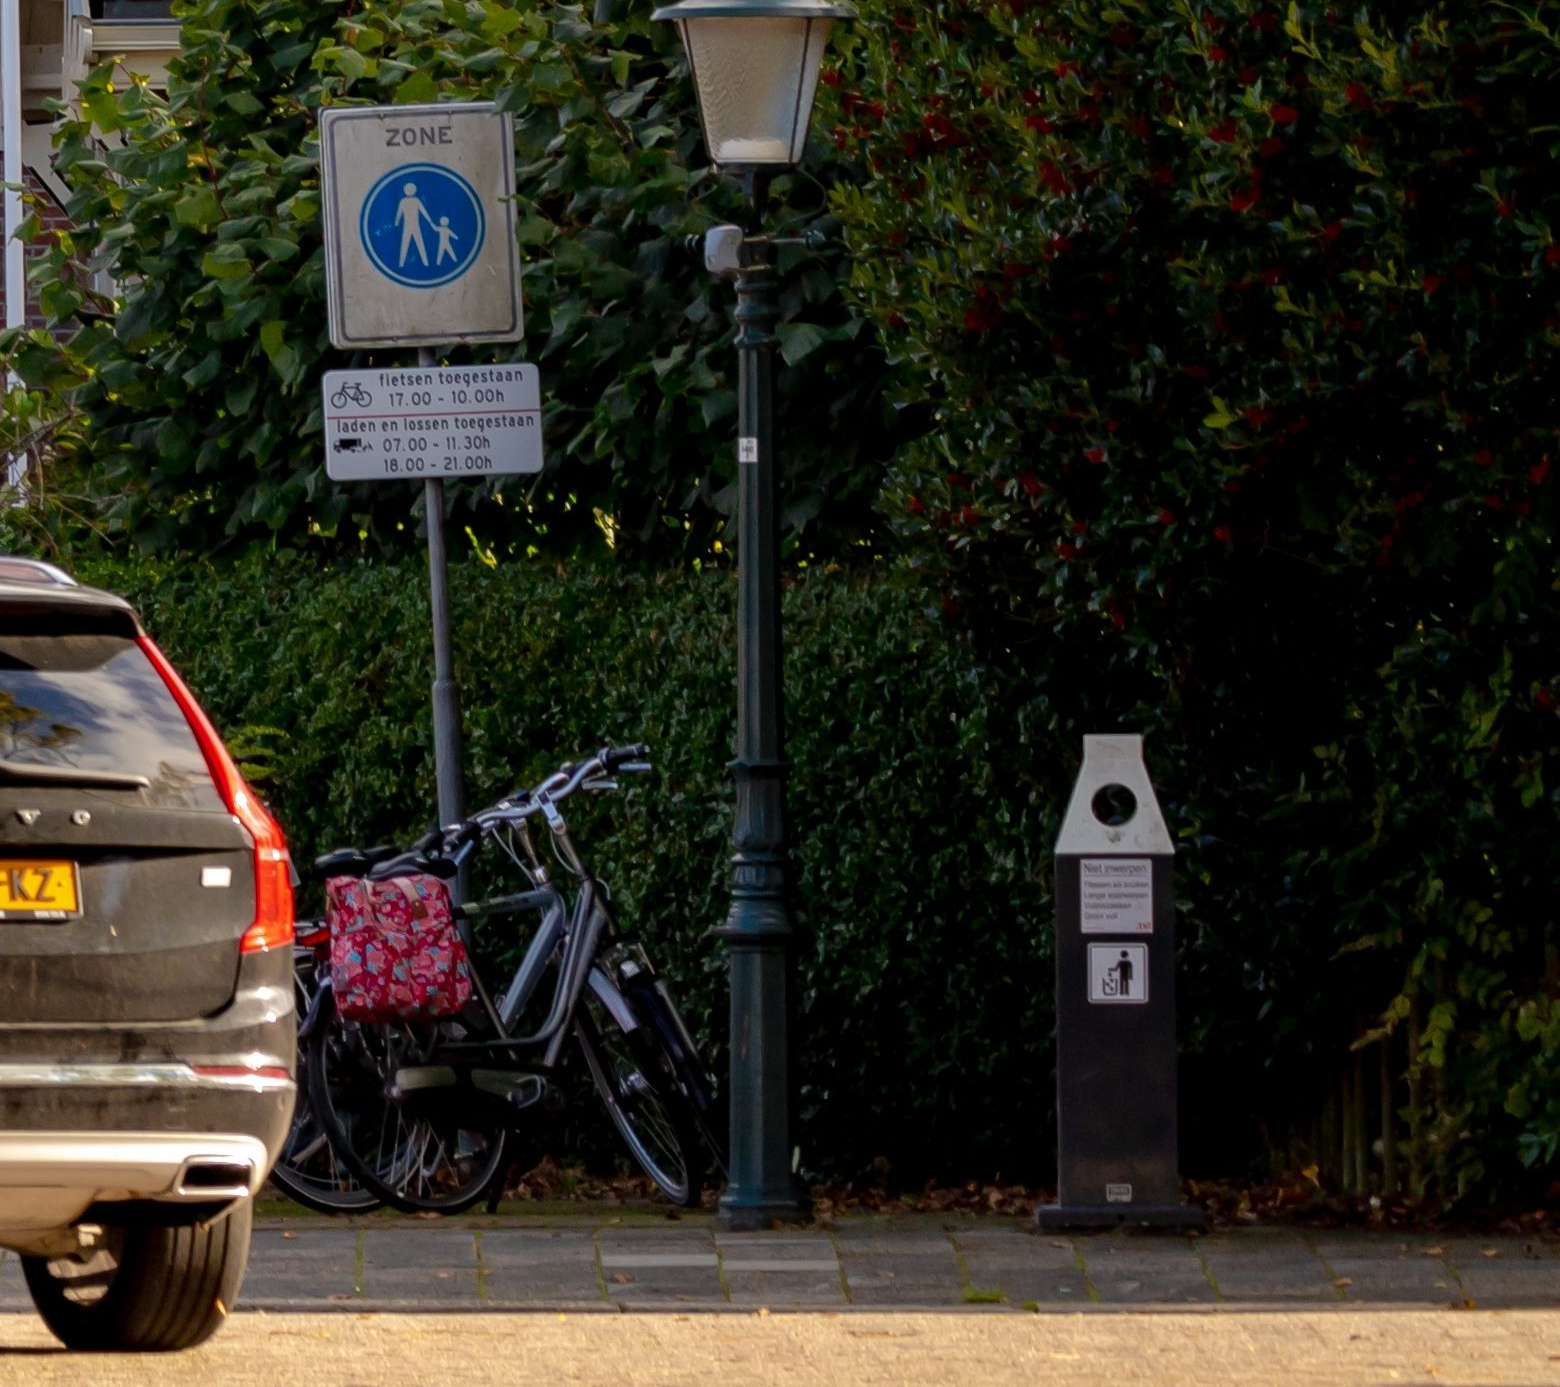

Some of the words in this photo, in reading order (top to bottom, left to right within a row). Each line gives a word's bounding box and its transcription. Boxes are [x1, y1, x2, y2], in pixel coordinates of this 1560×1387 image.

[385, 125, 454, 148] ZONE
[379, 372, 433, 388] fietsen
[438, 369, 524, 388] toegestaan
[389, 392, 432, 407] 17.00
[451, 389, 505, 405] 10.00h
[336, 418, 376, 433] laden
[381, 420, 398, 432] en
[403, 417, 449, 431] lossen
[454, 414, 535, 433] toegestaan
[382, 437, 427, 453] 07.00
[445, 436, 491, 452] 11.30h
[383, 457, 425, 473] 18.00
[443, 456, 492, 471] 21.00h
